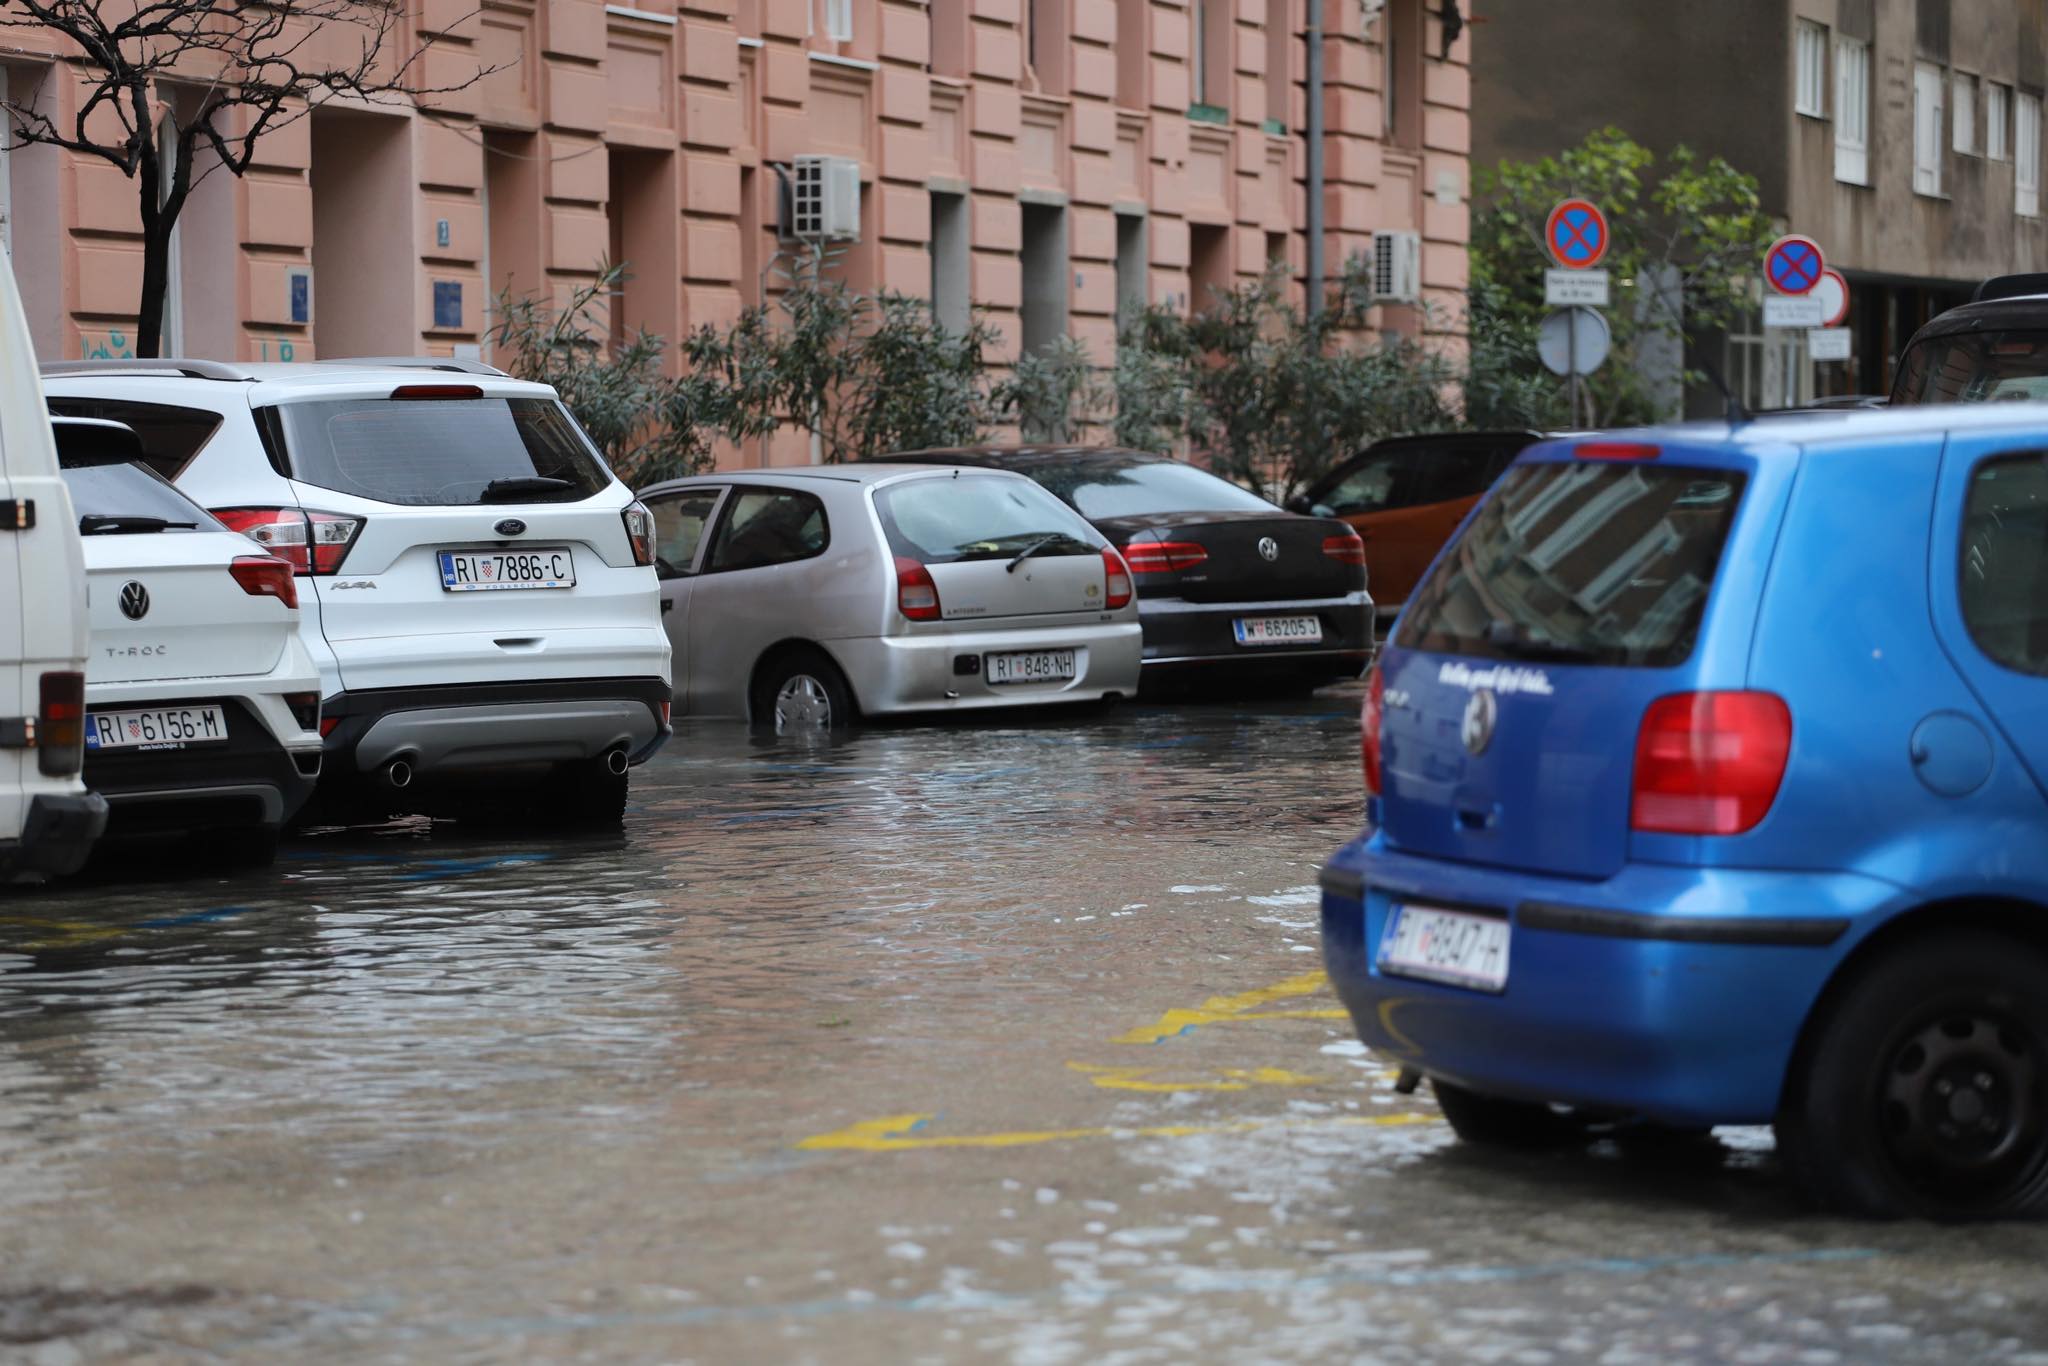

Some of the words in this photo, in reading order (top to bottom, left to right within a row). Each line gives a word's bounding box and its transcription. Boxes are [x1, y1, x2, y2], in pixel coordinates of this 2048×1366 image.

[455, 557, 479, 582] RI
[493, 554, 565, 581] 7886-C
[1245, 621, 1255, 636] W
[106, 645, 167, 657] T-ROC
[997, 658, 1012, 677] RI
[1025, 655, 1072, 676] 848-NH
[98, 715, 124, 744] RI
[140, 709, 219, 741] 6156-M
